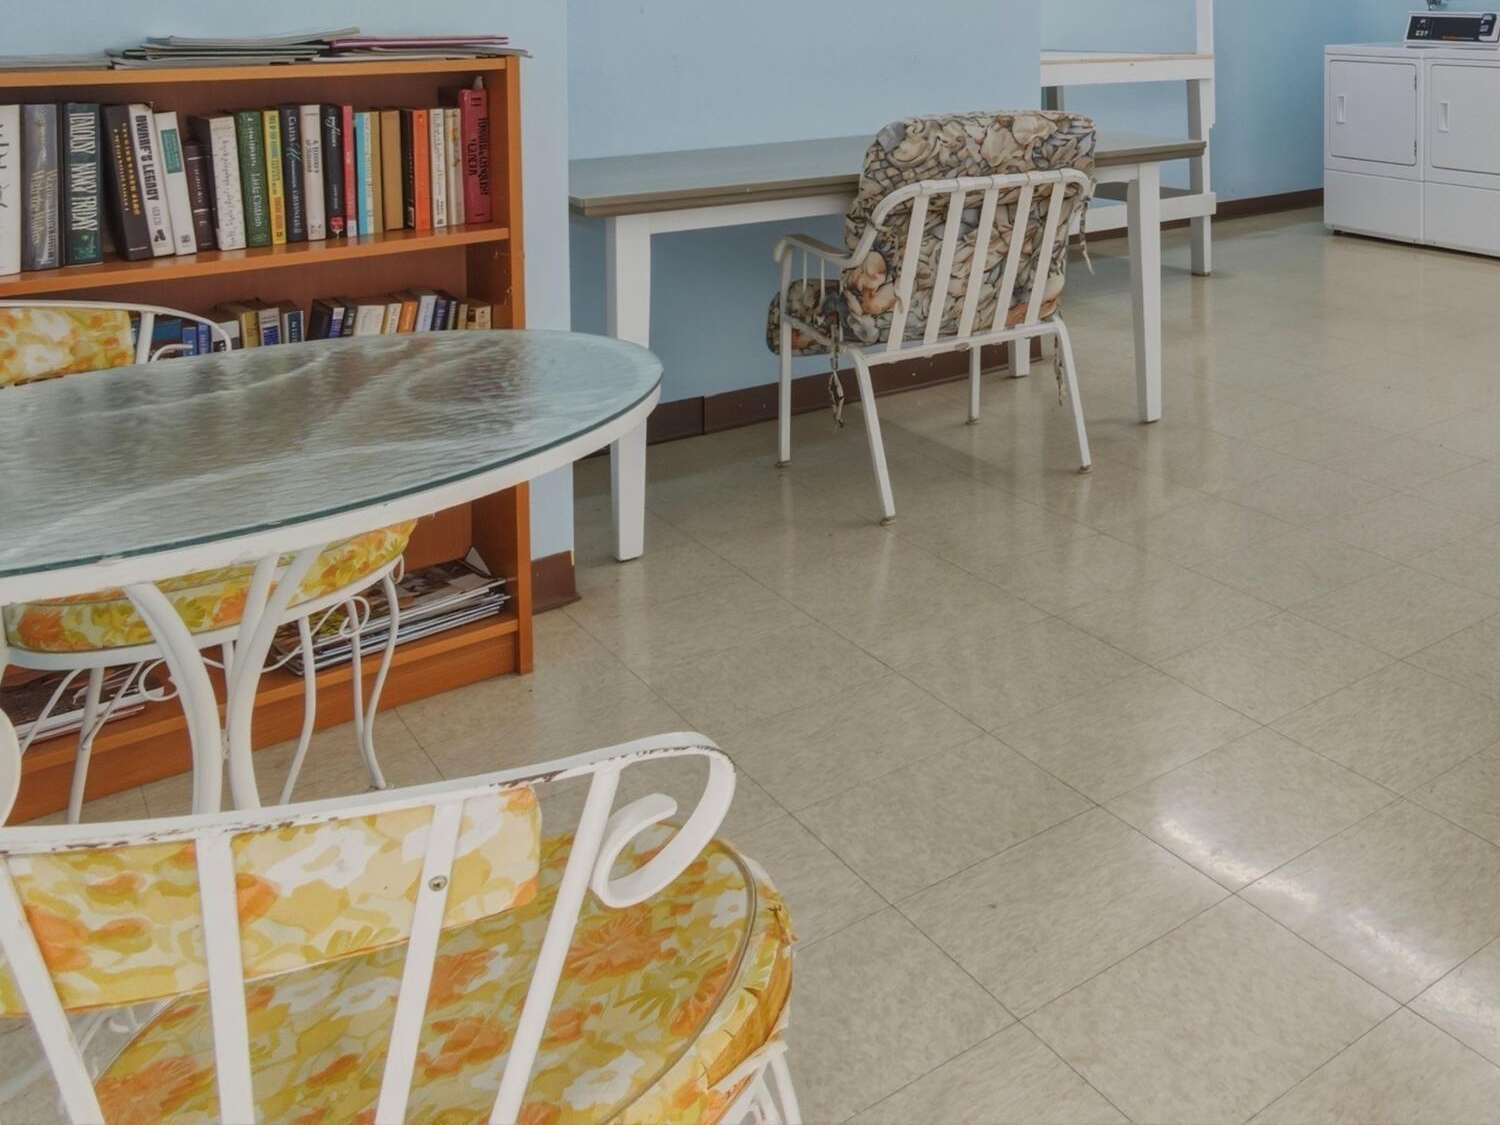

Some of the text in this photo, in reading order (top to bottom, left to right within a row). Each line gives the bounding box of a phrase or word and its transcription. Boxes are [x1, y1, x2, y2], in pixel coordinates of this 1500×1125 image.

[69, 112, 98, 231] JEALOUSY NANCY FRIDAY
[143, 163, 159, 201] LEGACY
